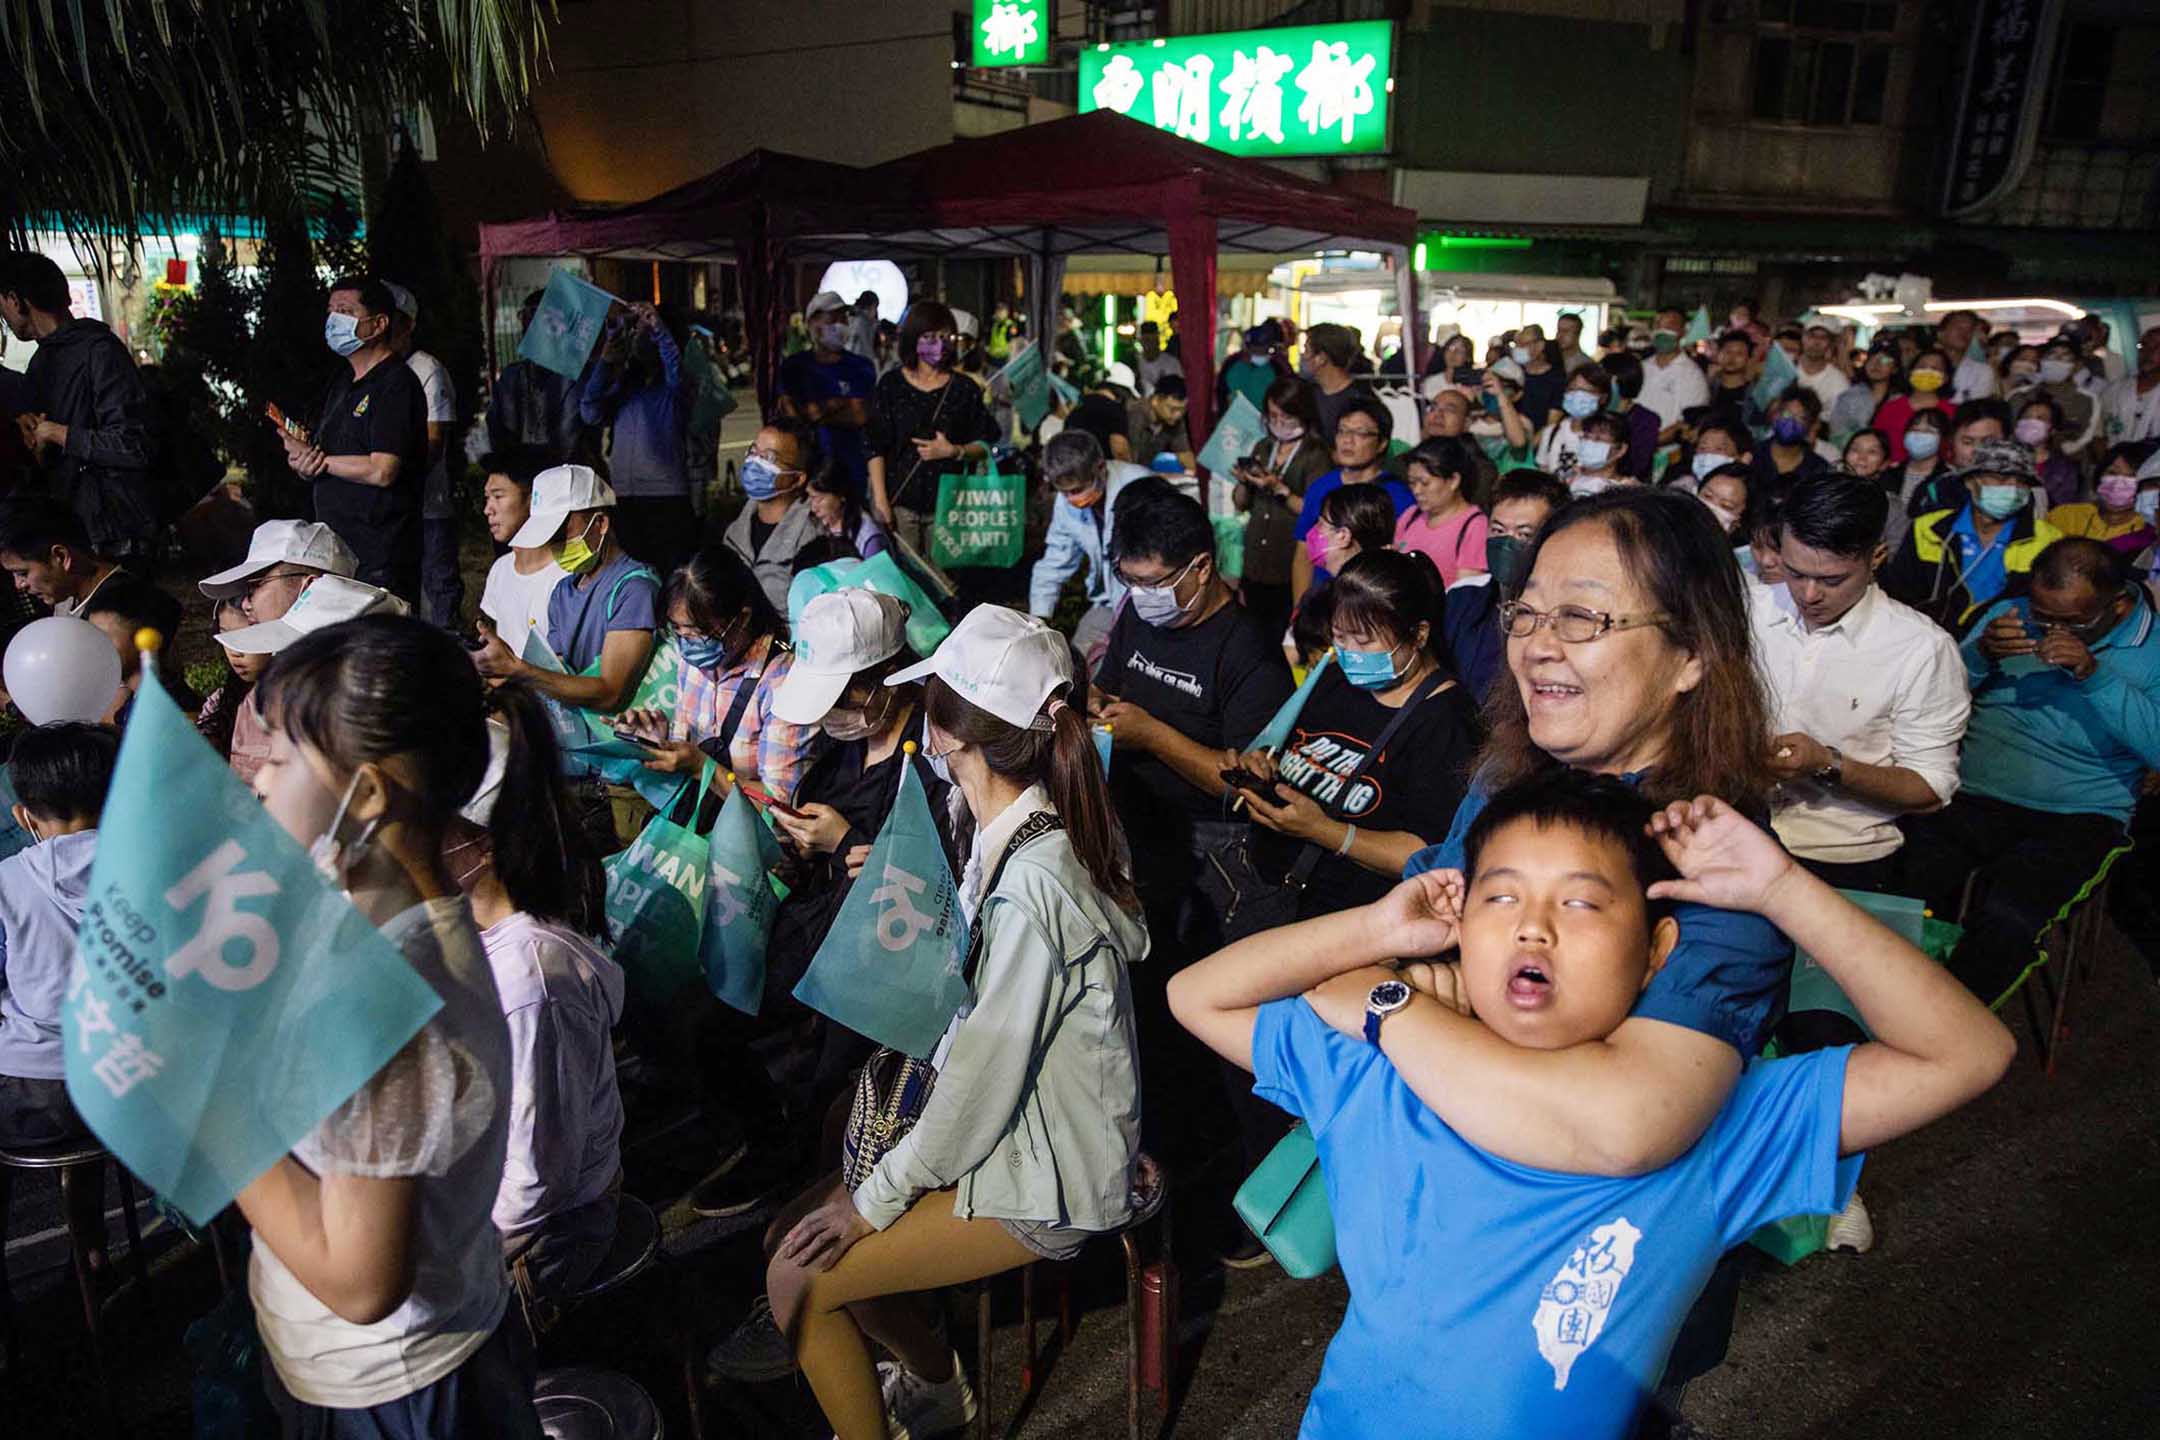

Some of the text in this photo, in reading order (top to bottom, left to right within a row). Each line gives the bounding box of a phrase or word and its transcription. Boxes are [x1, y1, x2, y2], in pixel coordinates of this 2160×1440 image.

[981, 0, 1037, 59] 榔
[91, 903, 167, 999] Promise
[68, 952, 165, 1098] 文哲
